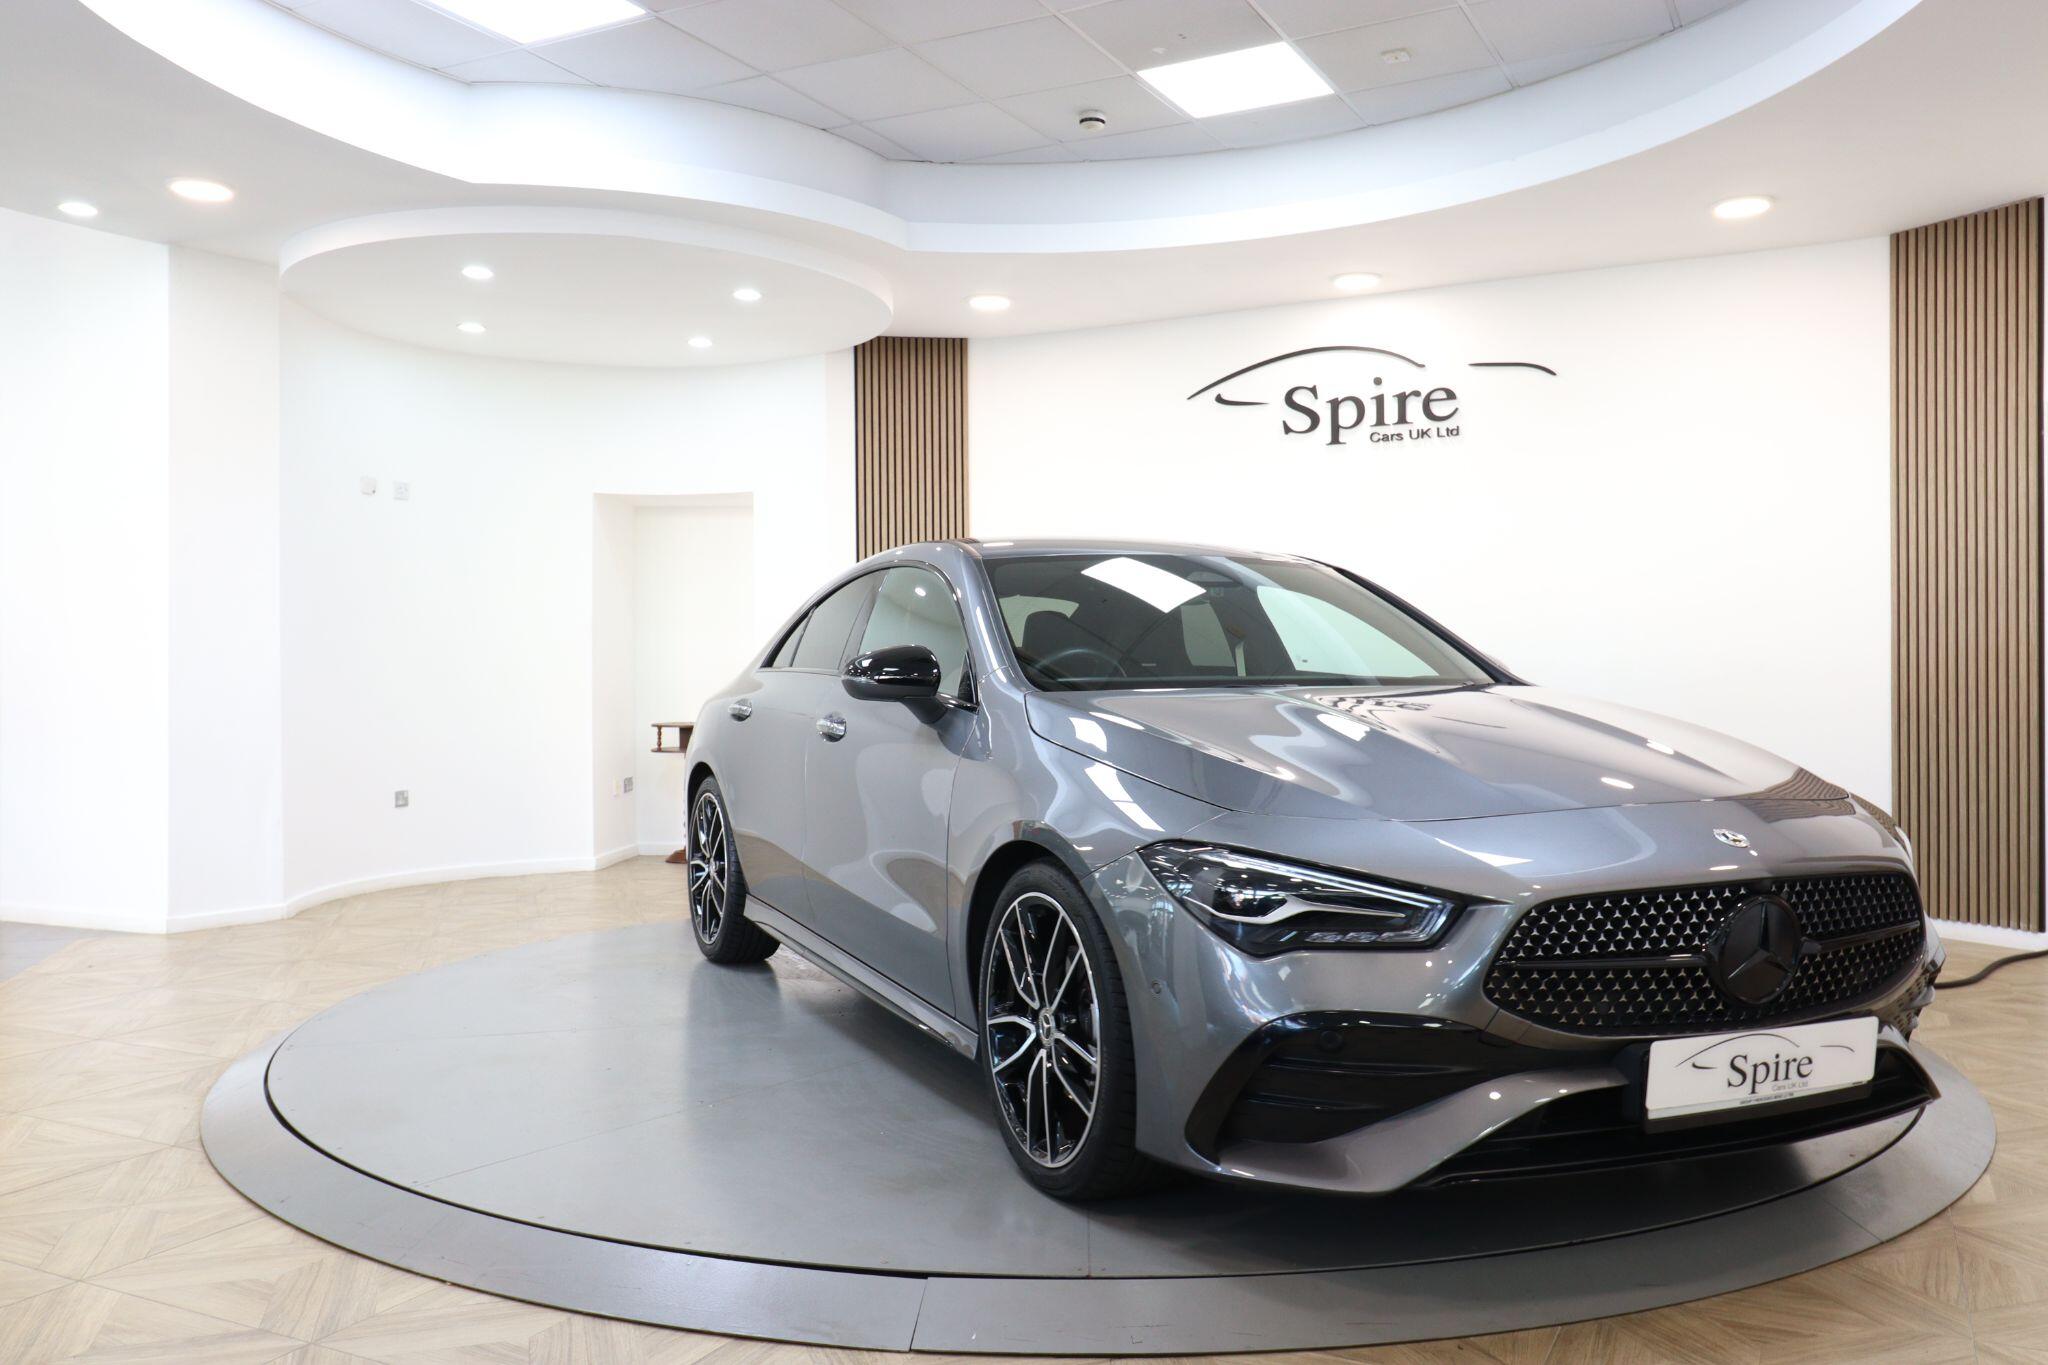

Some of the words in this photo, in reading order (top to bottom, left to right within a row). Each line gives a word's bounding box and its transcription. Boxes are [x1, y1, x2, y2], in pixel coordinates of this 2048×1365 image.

[1282, 376, 1460, 446] Spire
[1369, 431, 1404, 443] Cars
[1408, 427, 1432, 440] UK
[1436, 425, 1460, 438] Ltd
[1726, 1053, 1813, 1095] Spire
